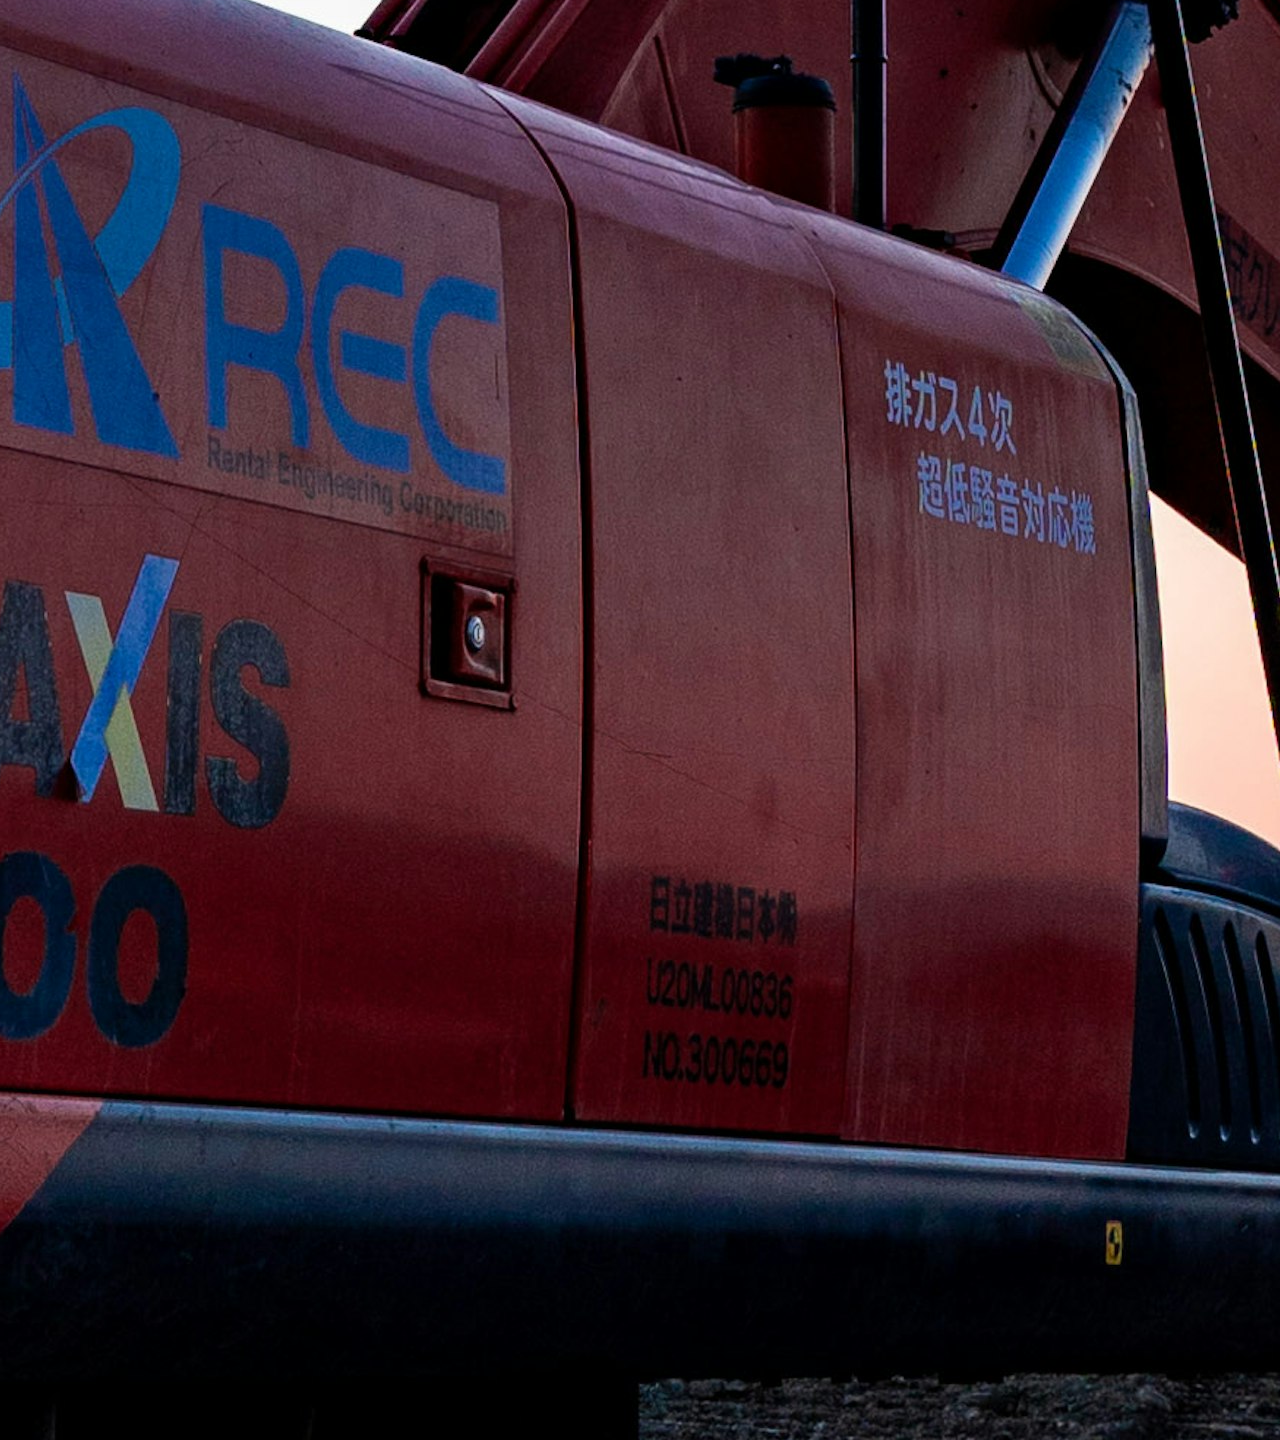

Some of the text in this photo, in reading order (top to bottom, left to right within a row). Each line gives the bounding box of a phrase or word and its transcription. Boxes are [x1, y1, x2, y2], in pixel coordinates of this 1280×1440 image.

[202, 202, 506, 494] REC
[884, 359, 1017, 456] 排ガス4次
[207, 434, 507, 534] Rental Engineering Corporation
[917, 450, 1096, 555] 超低騒音対応機
